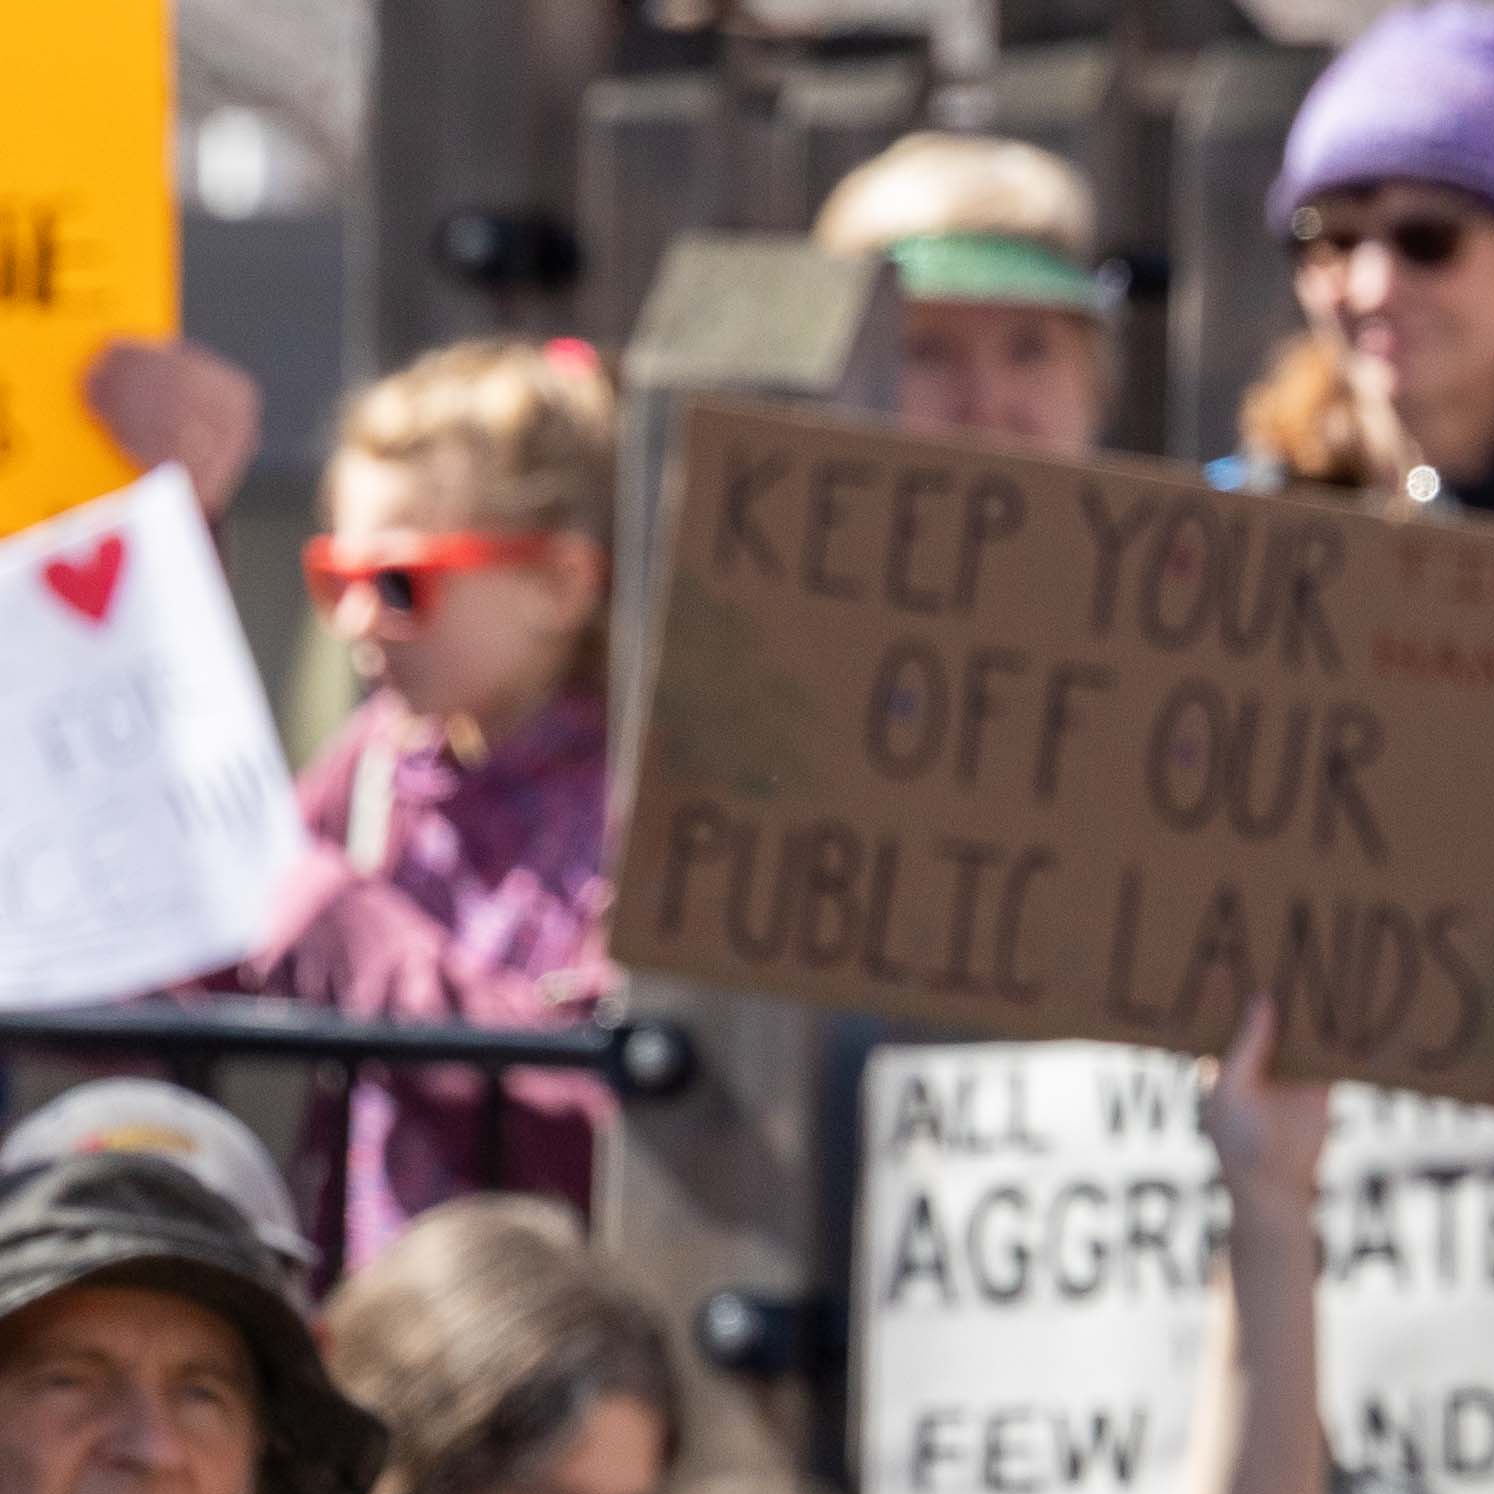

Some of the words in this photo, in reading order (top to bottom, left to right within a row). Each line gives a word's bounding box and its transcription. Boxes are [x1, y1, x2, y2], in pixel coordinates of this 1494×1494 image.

[712, 446, 1027, 615] KEEP
[1079, 476, 1348, 674] YOUR
[866, 636, 1117, 796] OFF
[1148, 672, 1388, 863] OUR
[658, 802, 1058, 1000] PUBLIC
[1110, 877, 1492, 1072] LANDS
[893, 1072, 1050, 1152] ALL
